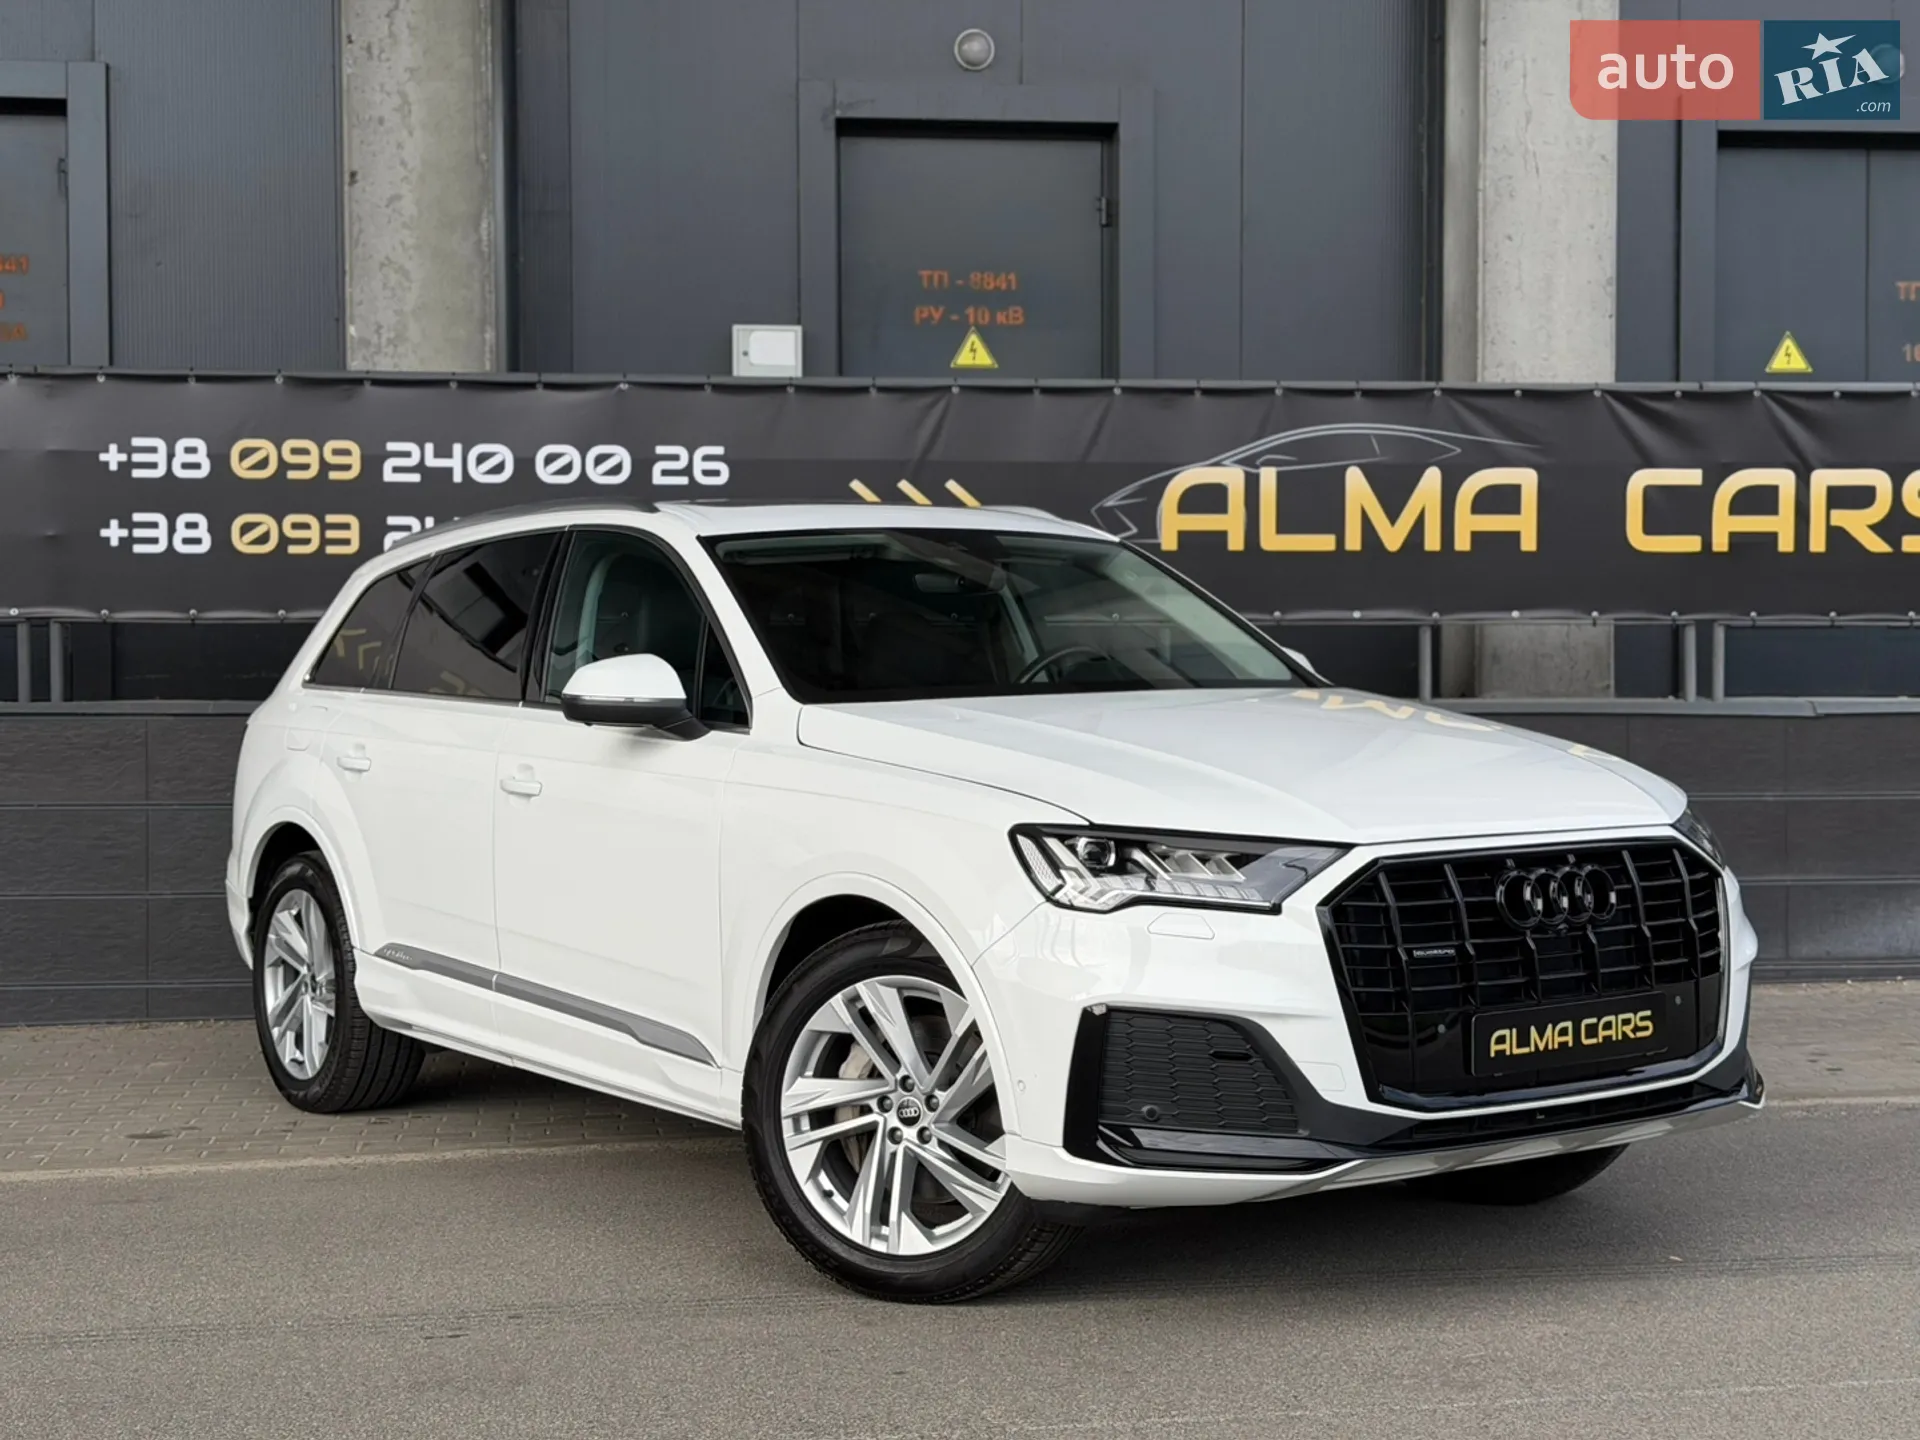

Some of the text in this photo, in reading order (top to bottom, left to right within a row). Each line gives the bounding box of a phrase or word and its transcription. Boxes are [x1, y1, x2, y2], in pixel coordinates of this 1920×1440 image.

[918, 270, 949, 288] ТП
[964, 306, 991, 325] 10
[99, 437, 730, 486] +38 099 240 00 26
[1160, 466, 1920, 553] ALMA CAR
[99, 512, 211, 554] +38
[230, 513, 361, 555] 093
[1489, 1010, 1654, 1058] ALMA CARS
